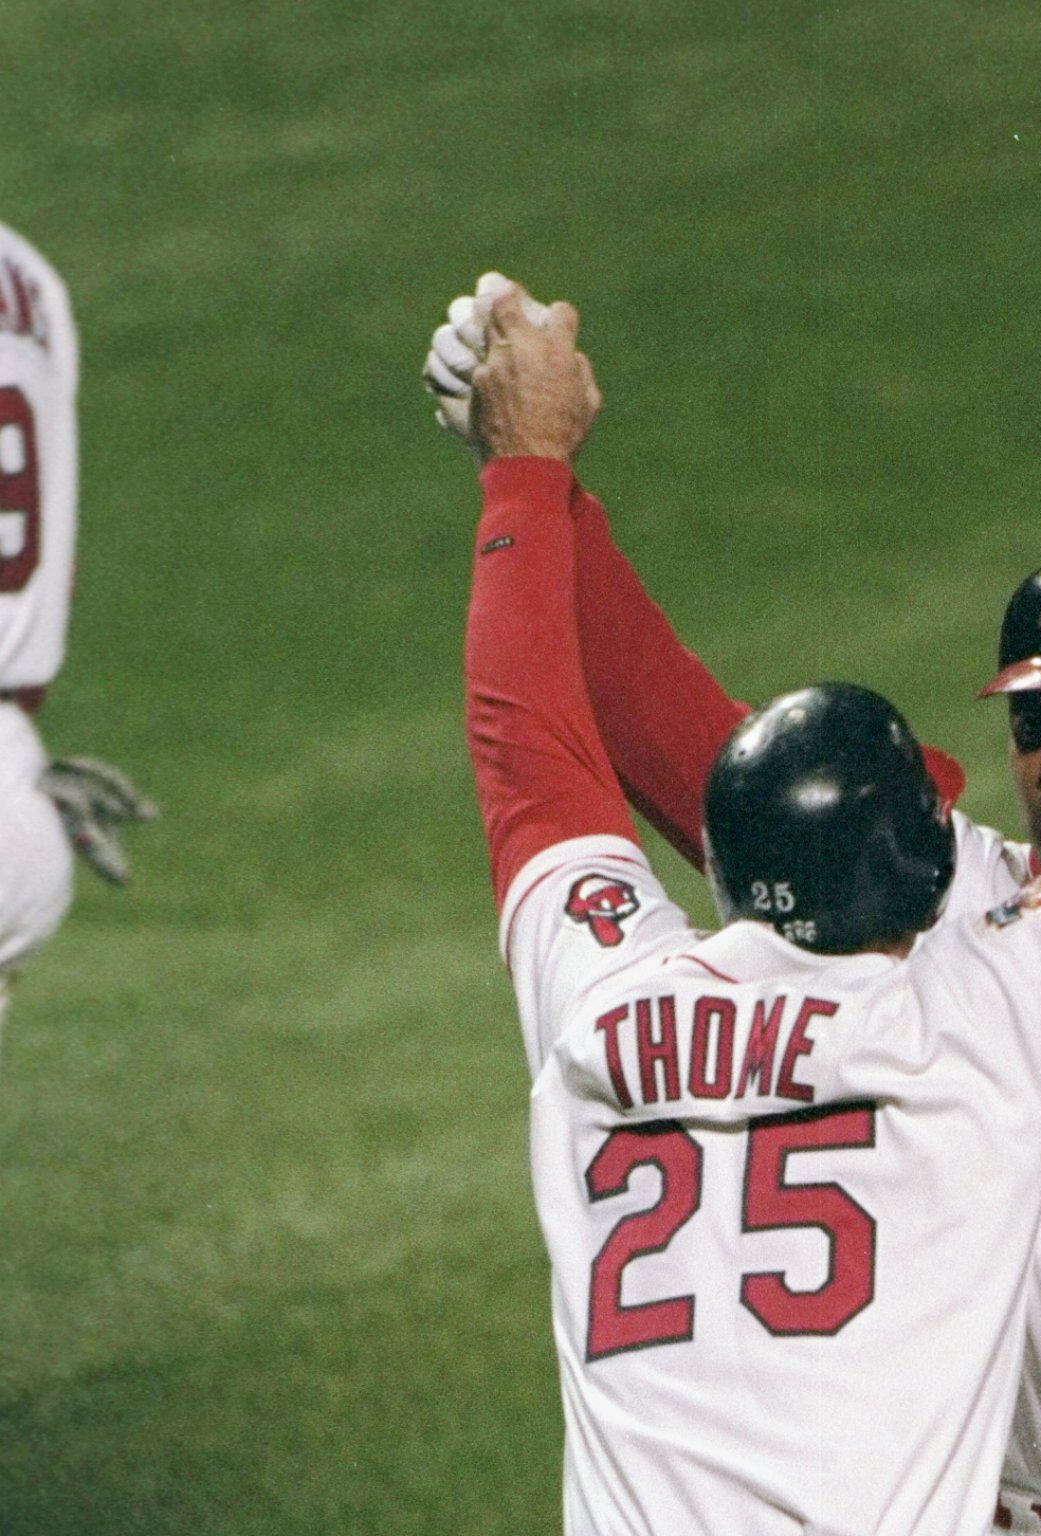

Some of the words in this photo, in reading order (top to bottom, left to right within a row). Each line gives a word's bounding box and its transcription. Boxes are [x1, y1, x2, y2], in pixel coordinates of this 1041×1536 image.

[751, 881, 795, 912] 25
[595, 994, 840, 1109] THOME
[585, 1100, 877, 1363] 25
